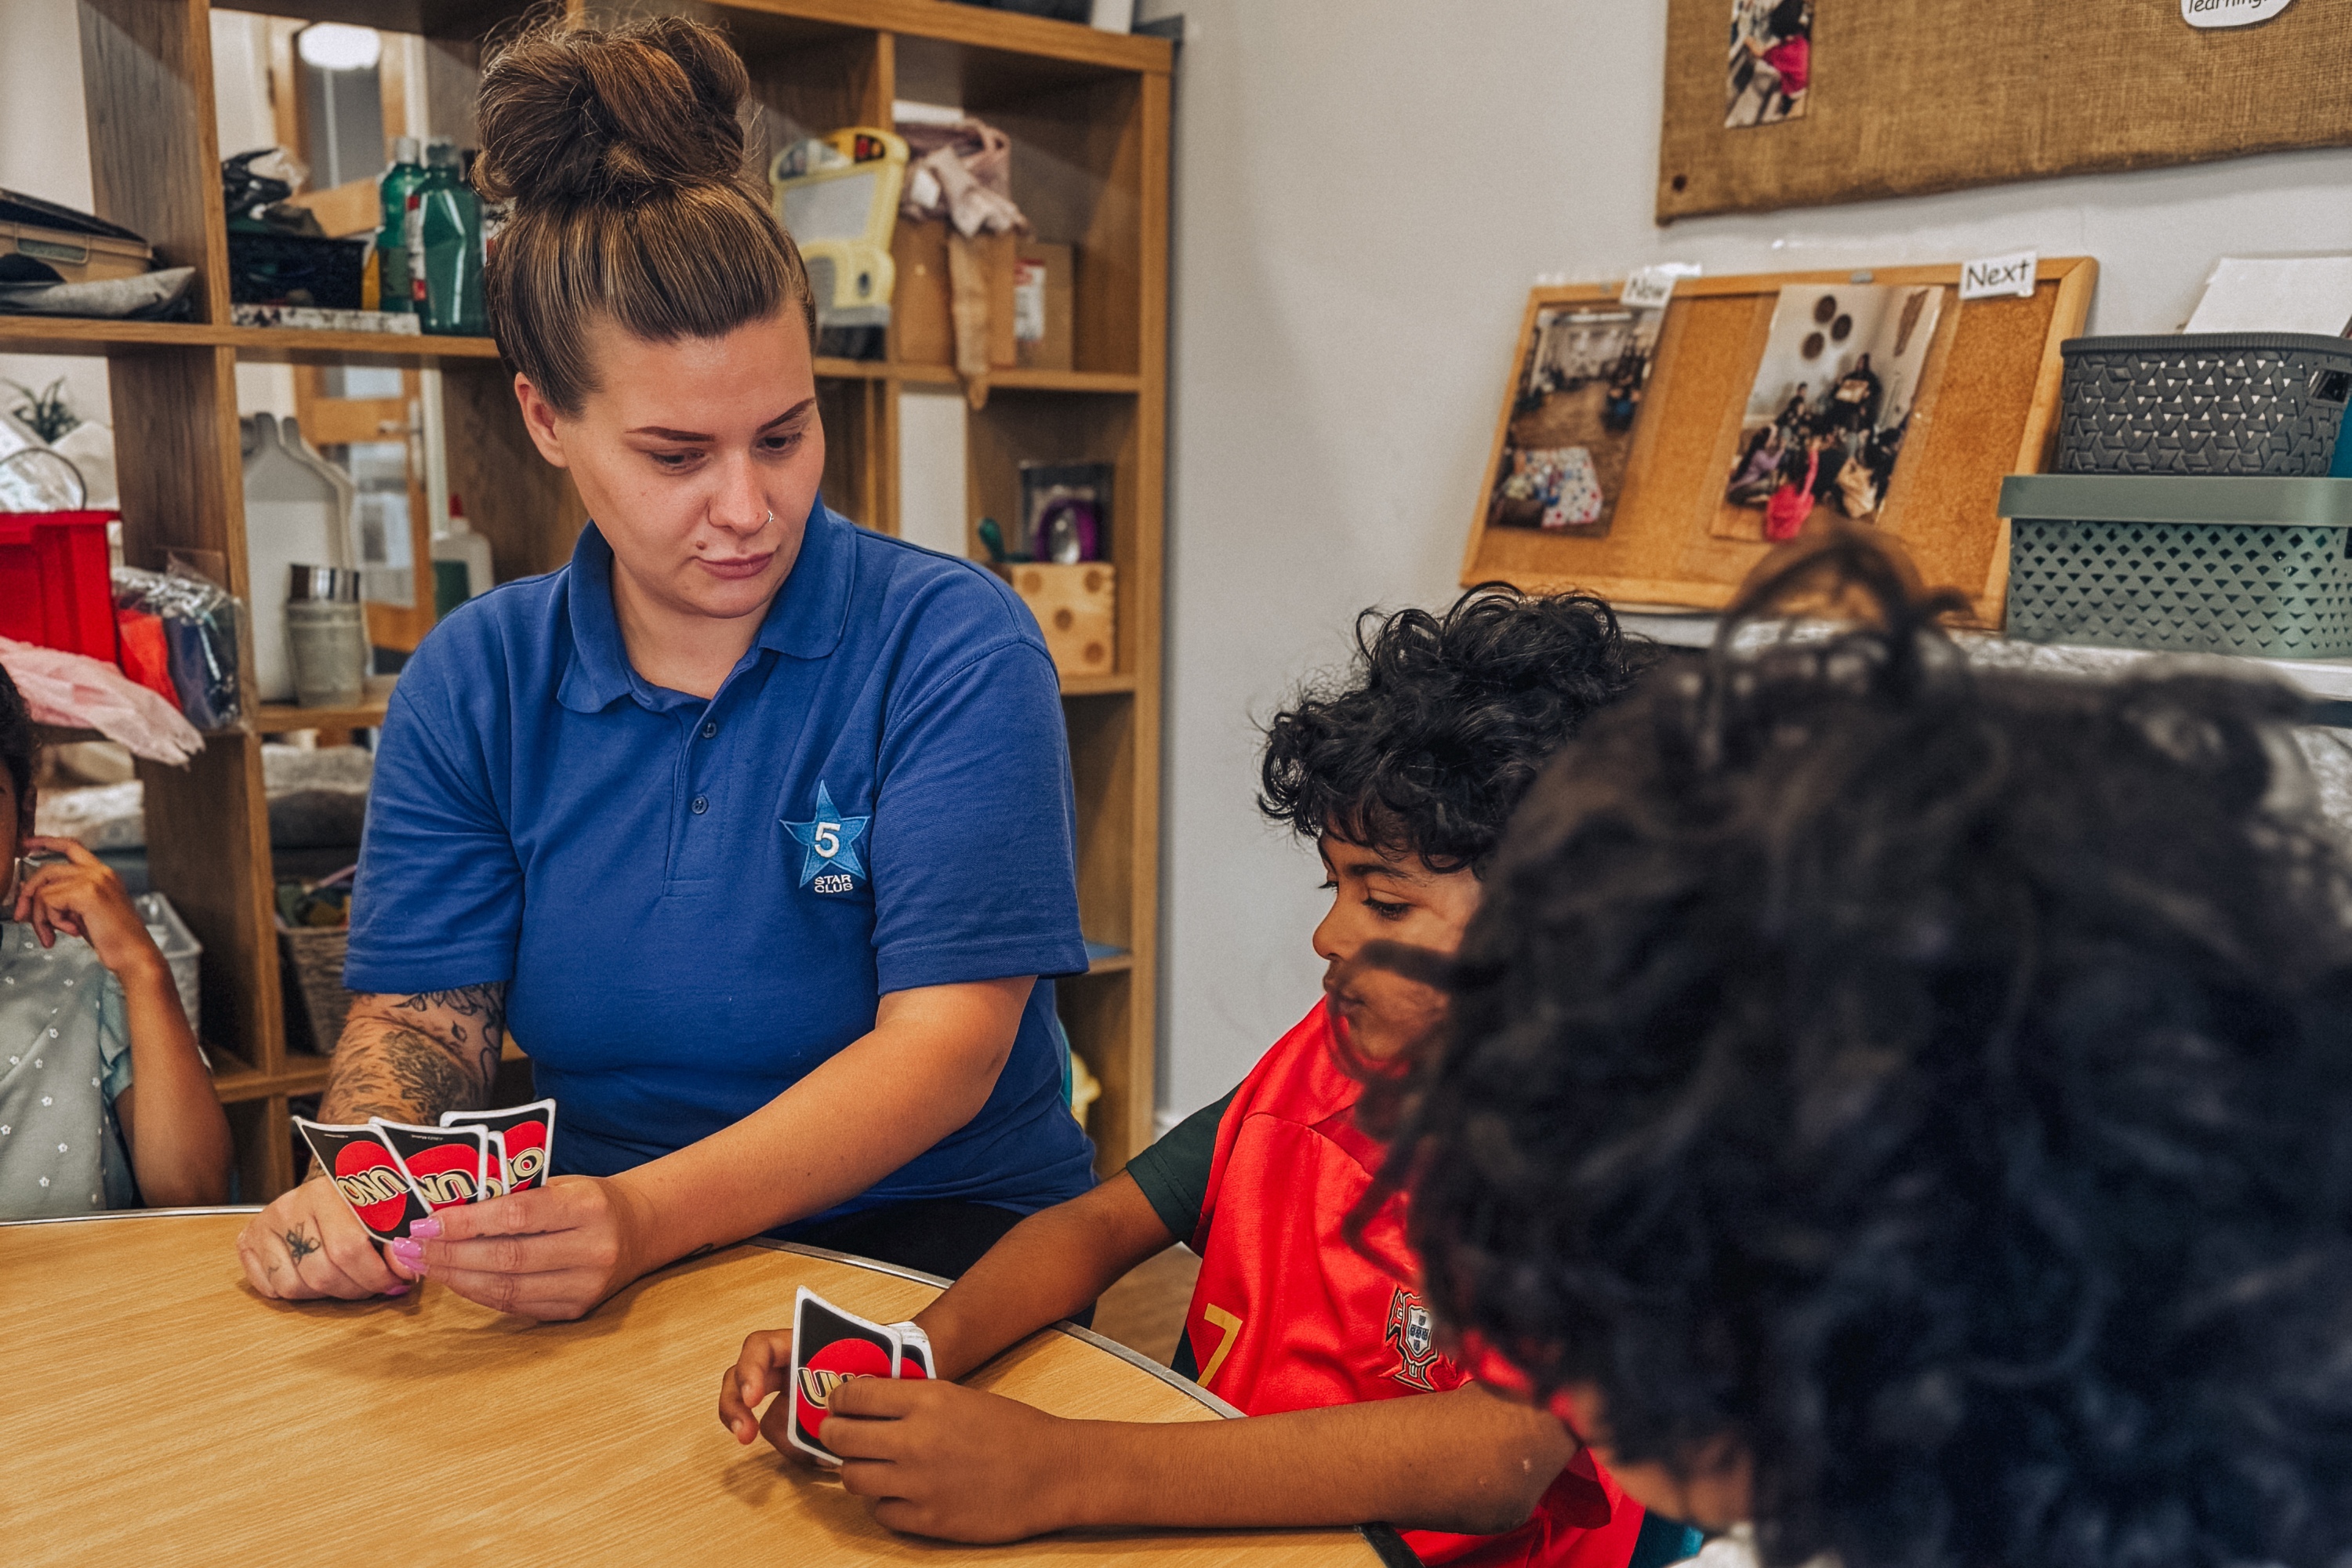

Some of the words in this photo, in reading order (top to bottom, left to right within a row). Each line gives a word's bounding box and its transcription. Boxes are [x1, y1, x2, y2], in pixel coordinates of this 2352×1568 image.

[1966, 260, 2029, 291] Next
[814, 822, 840, 858] 5
[814, 874, 851, 886] STAR
[814, 883, 853, 893] CLUB
[336, 1165, 411, 1207] UNO
[412, 1169, 478, 1204] UN
[1196, 1303, 1243, 1388] 7
